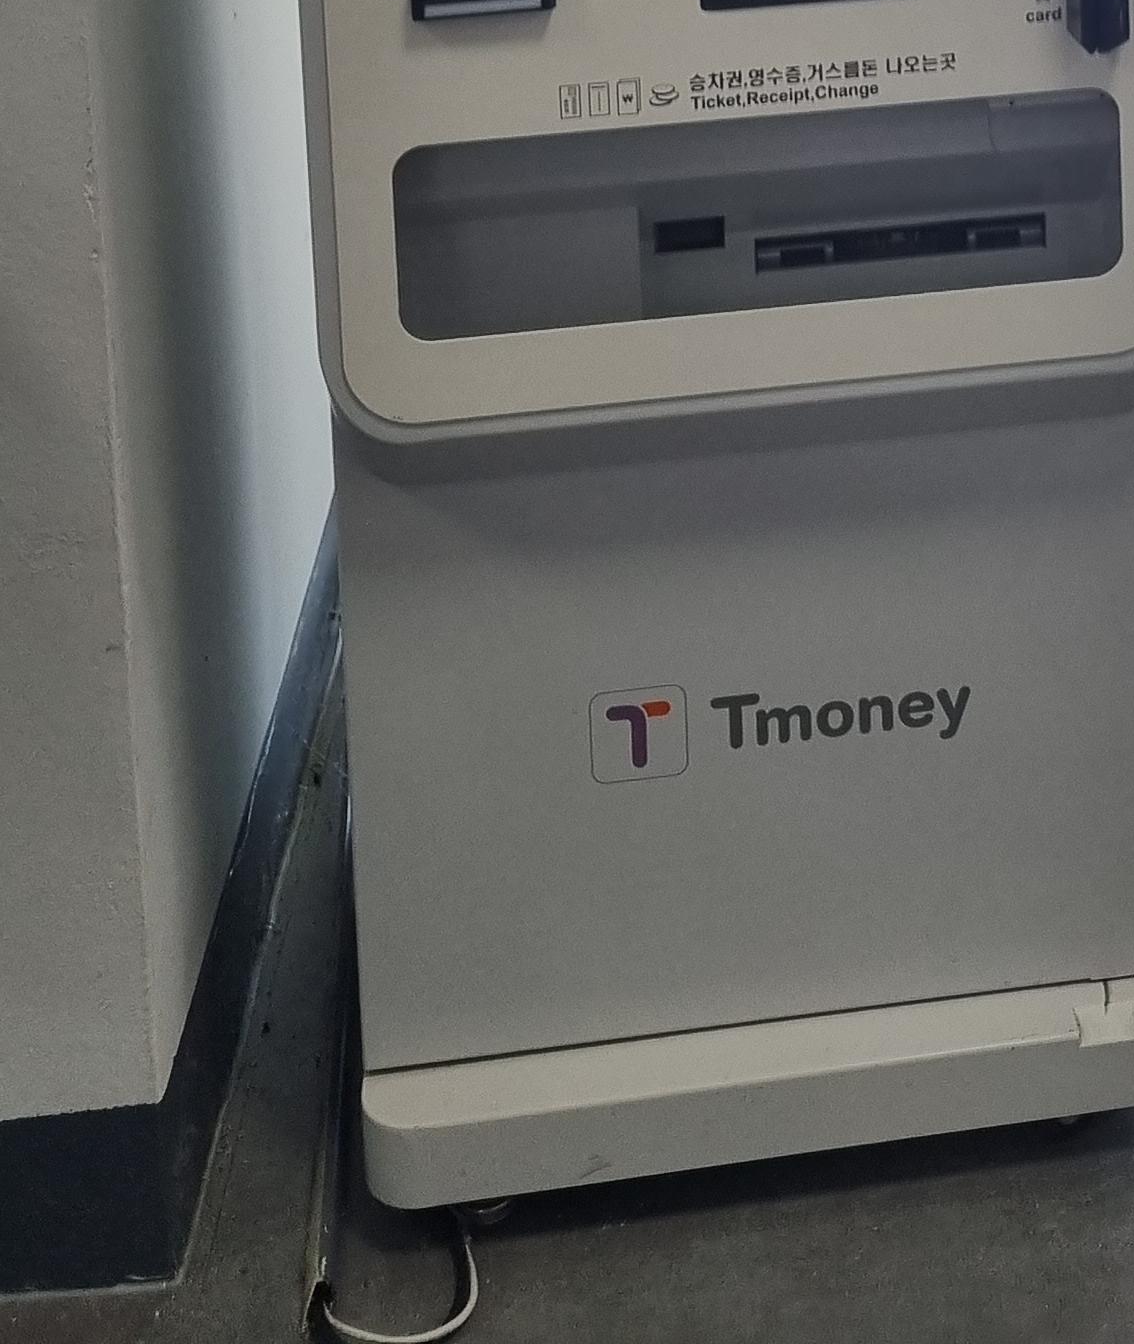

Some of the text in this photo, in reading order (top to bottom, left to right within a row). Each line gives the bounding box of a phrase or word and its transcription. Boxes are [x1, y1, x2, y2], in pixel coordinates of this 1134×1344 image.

[1025, 6, 1062, 23] card
[885, 52, 958, 75] 나오는곳
[690, 82, 880, 111] Ticket,Receipt,Change
[710, 685, 971, 749] Tmoney
